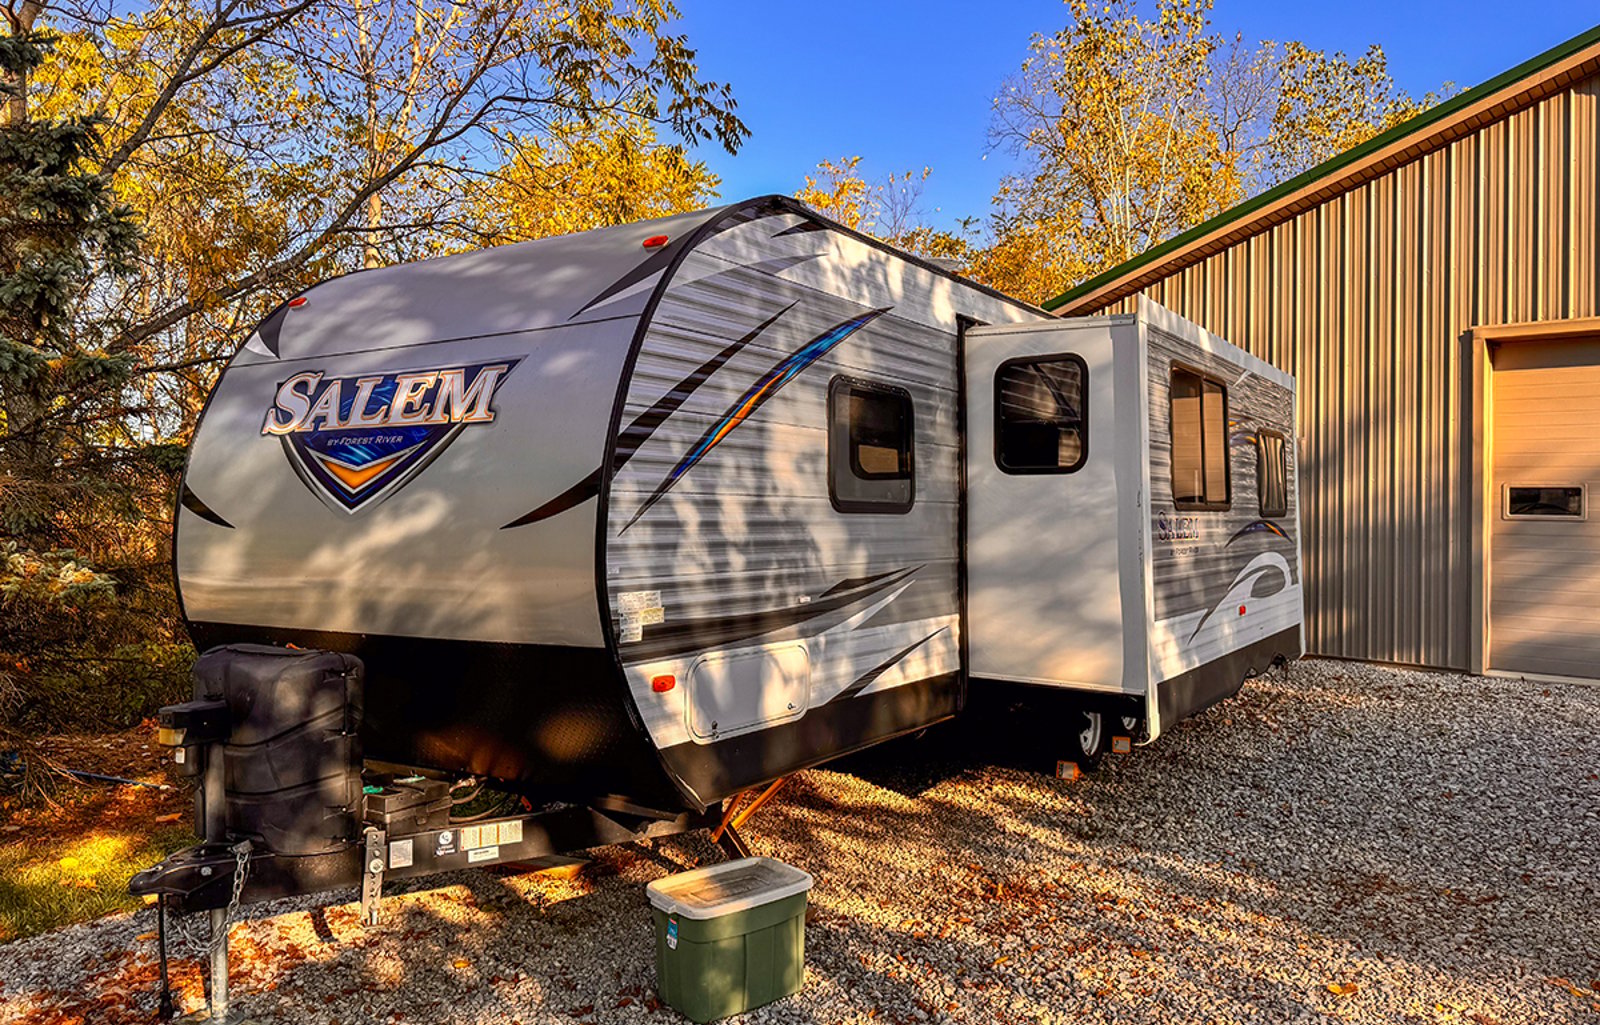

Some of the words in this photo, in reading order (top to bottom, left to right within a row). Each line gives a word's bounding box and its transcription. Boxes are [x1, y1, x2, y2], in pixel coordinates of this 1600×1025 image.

[262, 365, 508, 435] SALEM
[339, 436, 375, 446] FOREST
[375, 435, 404, 444] RIVER
[1158, 511, 1200, 541] SALEM
